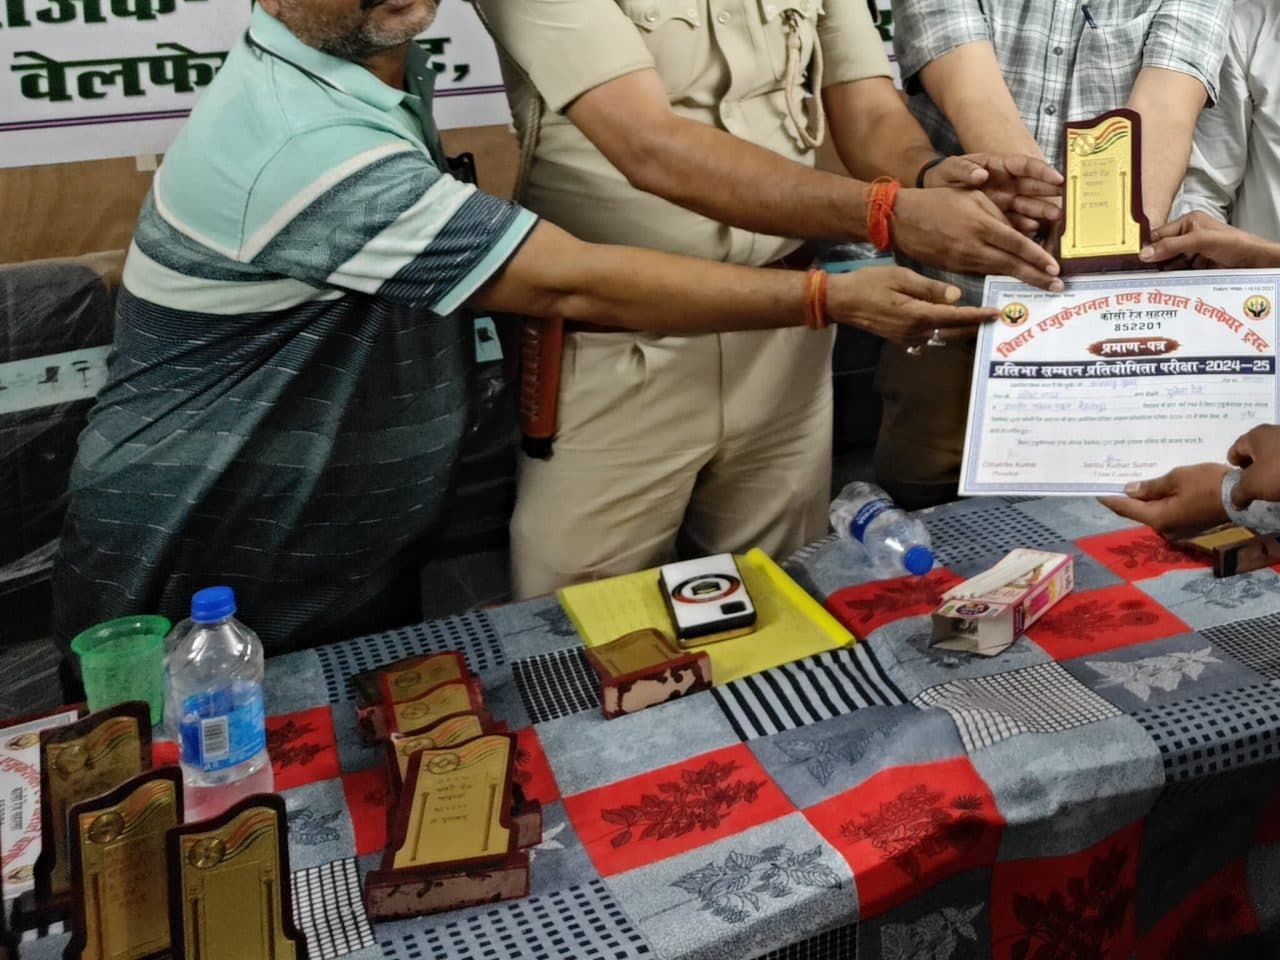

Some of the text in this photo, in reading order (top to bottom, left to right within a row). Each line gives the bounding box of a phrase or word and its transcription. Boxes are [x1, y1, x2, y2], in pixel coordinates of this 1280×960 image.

[11, 42, 229, 103] वेलफे
[996, 327, 1035, 358] बिहार
[1146, 289, 1191, 310] सोशल
[1114, 321, 1162, 332] 852201
[1100, 340, 1167, 355] प्रमाण-पत्र
[993, 361, 1039, 378] प्रतिभा
[1041, 364, 1085, 378] सम्मान
[1085, 359, 1157, 377] प्रतियोगिता
